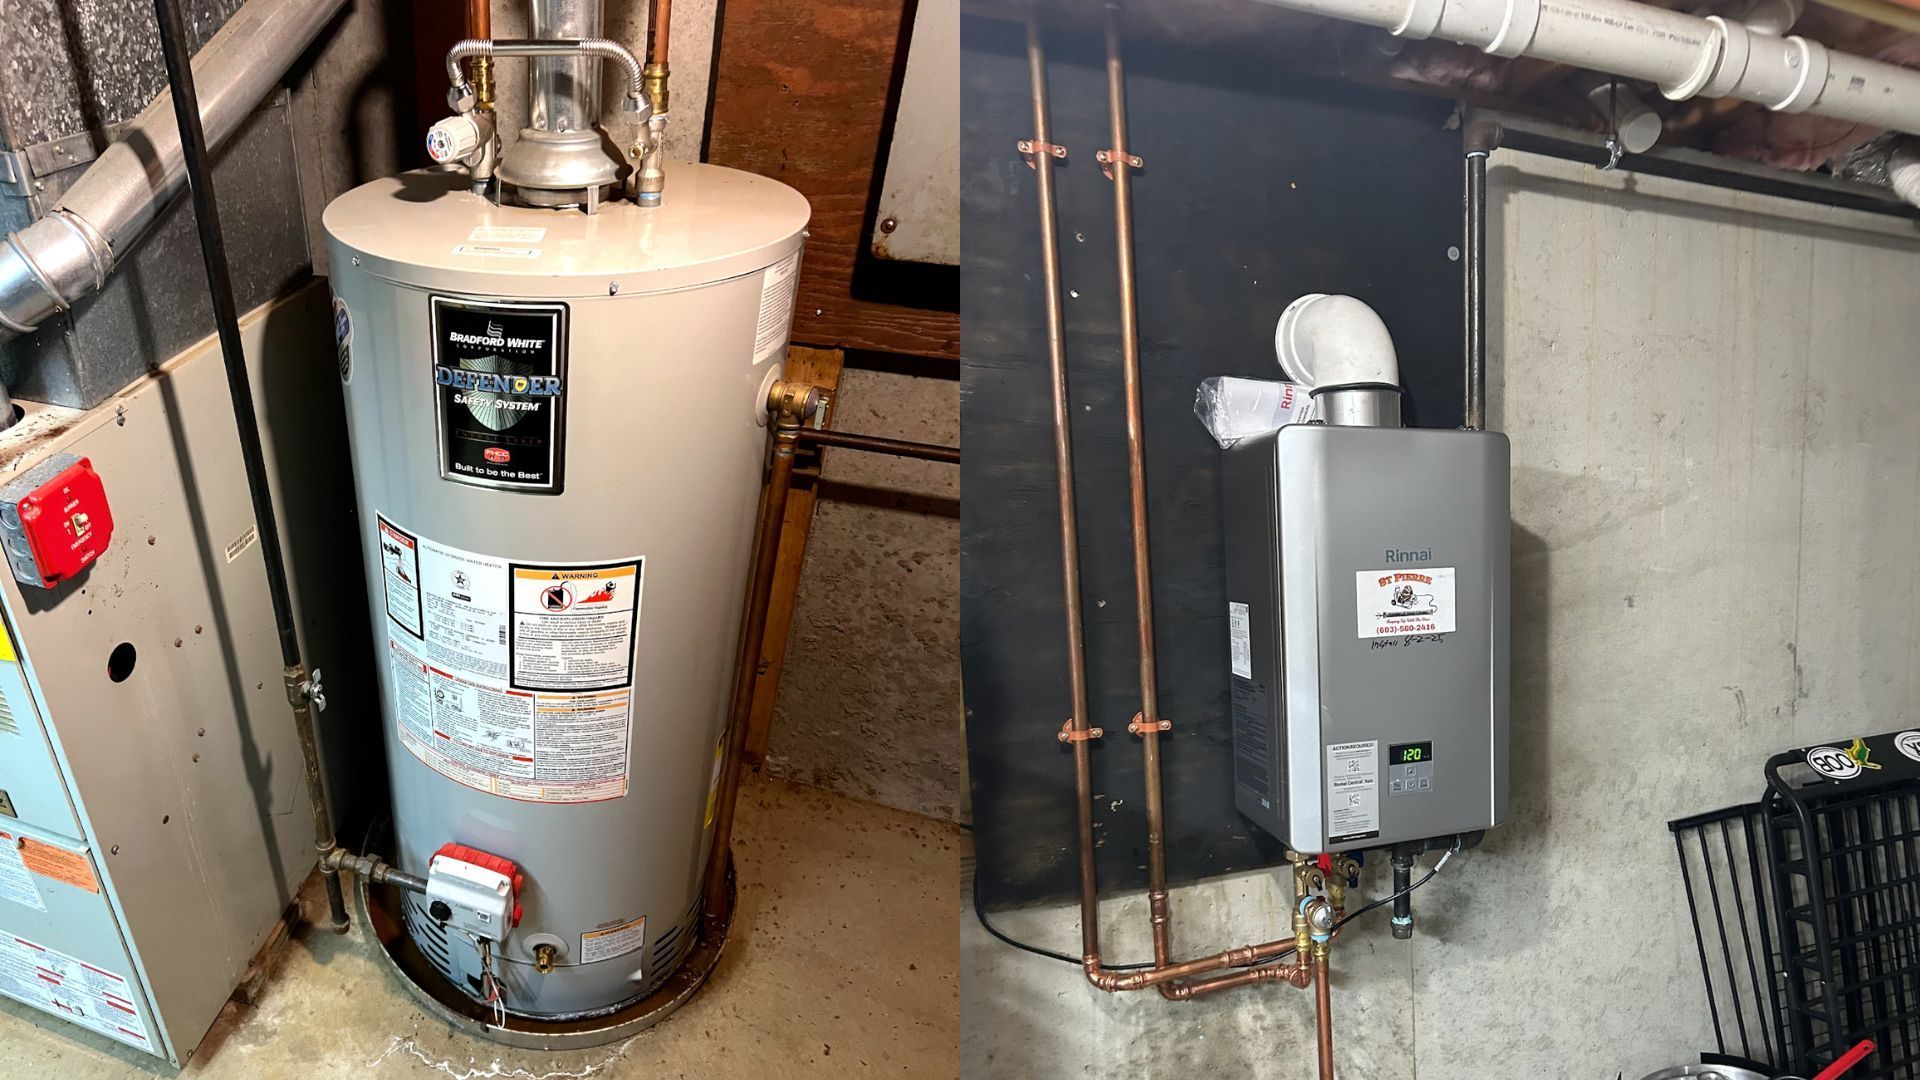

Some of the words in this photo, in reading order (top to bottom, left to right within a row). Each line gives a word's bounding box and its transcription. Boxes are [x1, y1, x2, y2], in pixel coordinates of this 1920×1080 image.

[450, 331, 504, 347] BRADFORD
[507, 337, 545, 348] WHITE
[456, 343, 535, 354] CORPORATION
[437, 365, 563, 396] DEFENDER
[454, 394, 492, 408] SAFETY
[495, 400, 540, 412] SYSTEM
[455, 462, 474, 473] Built
[475, 466, 485, 474] to
[486, 467, 499, 477] be
[500, 469, 516, 478] the
[517, 471, 541, 480] Best
[70, 531, 93, 551] EMERGENCY
[80, 549, 96, 564] SWITCH
[1385, 548, 1432, 563] Rinnai
[1378, 575, 1393, 588] ST
[1393, 572, 1433, 586] PIERRE
[1376, 623, 1436, 635] (603)-560-2416
[1402, 748, 1422, 761] 120
[1812, 752, 1855, 773] BOO
